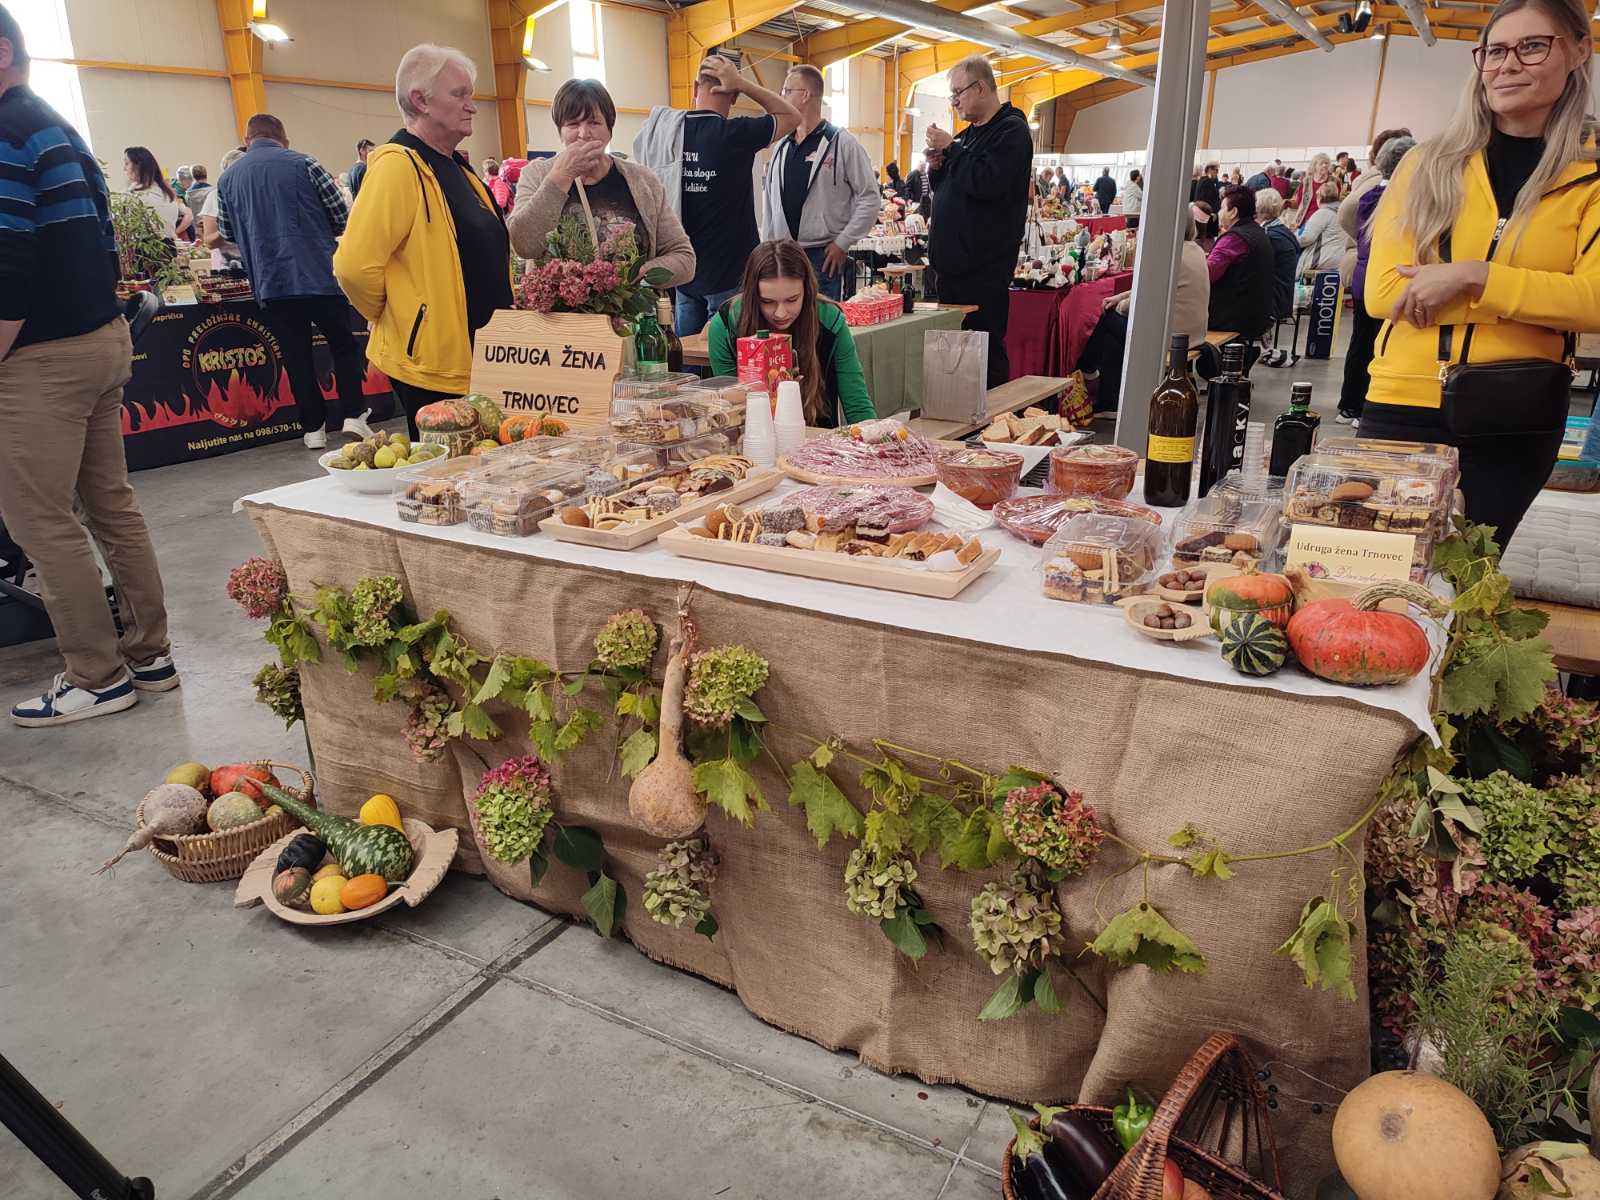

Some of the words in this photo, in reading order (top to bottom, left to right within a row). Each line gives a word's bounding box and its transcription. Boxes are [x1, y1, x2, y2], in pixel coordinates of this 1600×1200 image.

[693, 167, 718, 181] sloga
[1316, 274, 1339, 336] motion
[485, 345, 551, 366] UDRUGA
[560, 344, 606, 370] ŽENA
[502, 390, 580, 415] TRNOVEC
[188, 436, 227, 451] Naljutite
[228, 435, 243, 444] nas
[244, 431, 255, 440] na
[1296, 541, 1333, 555] Udruga
[1335, 545, 1359, 557] žena
[1362, 548, 1404, 561] Trnovec
